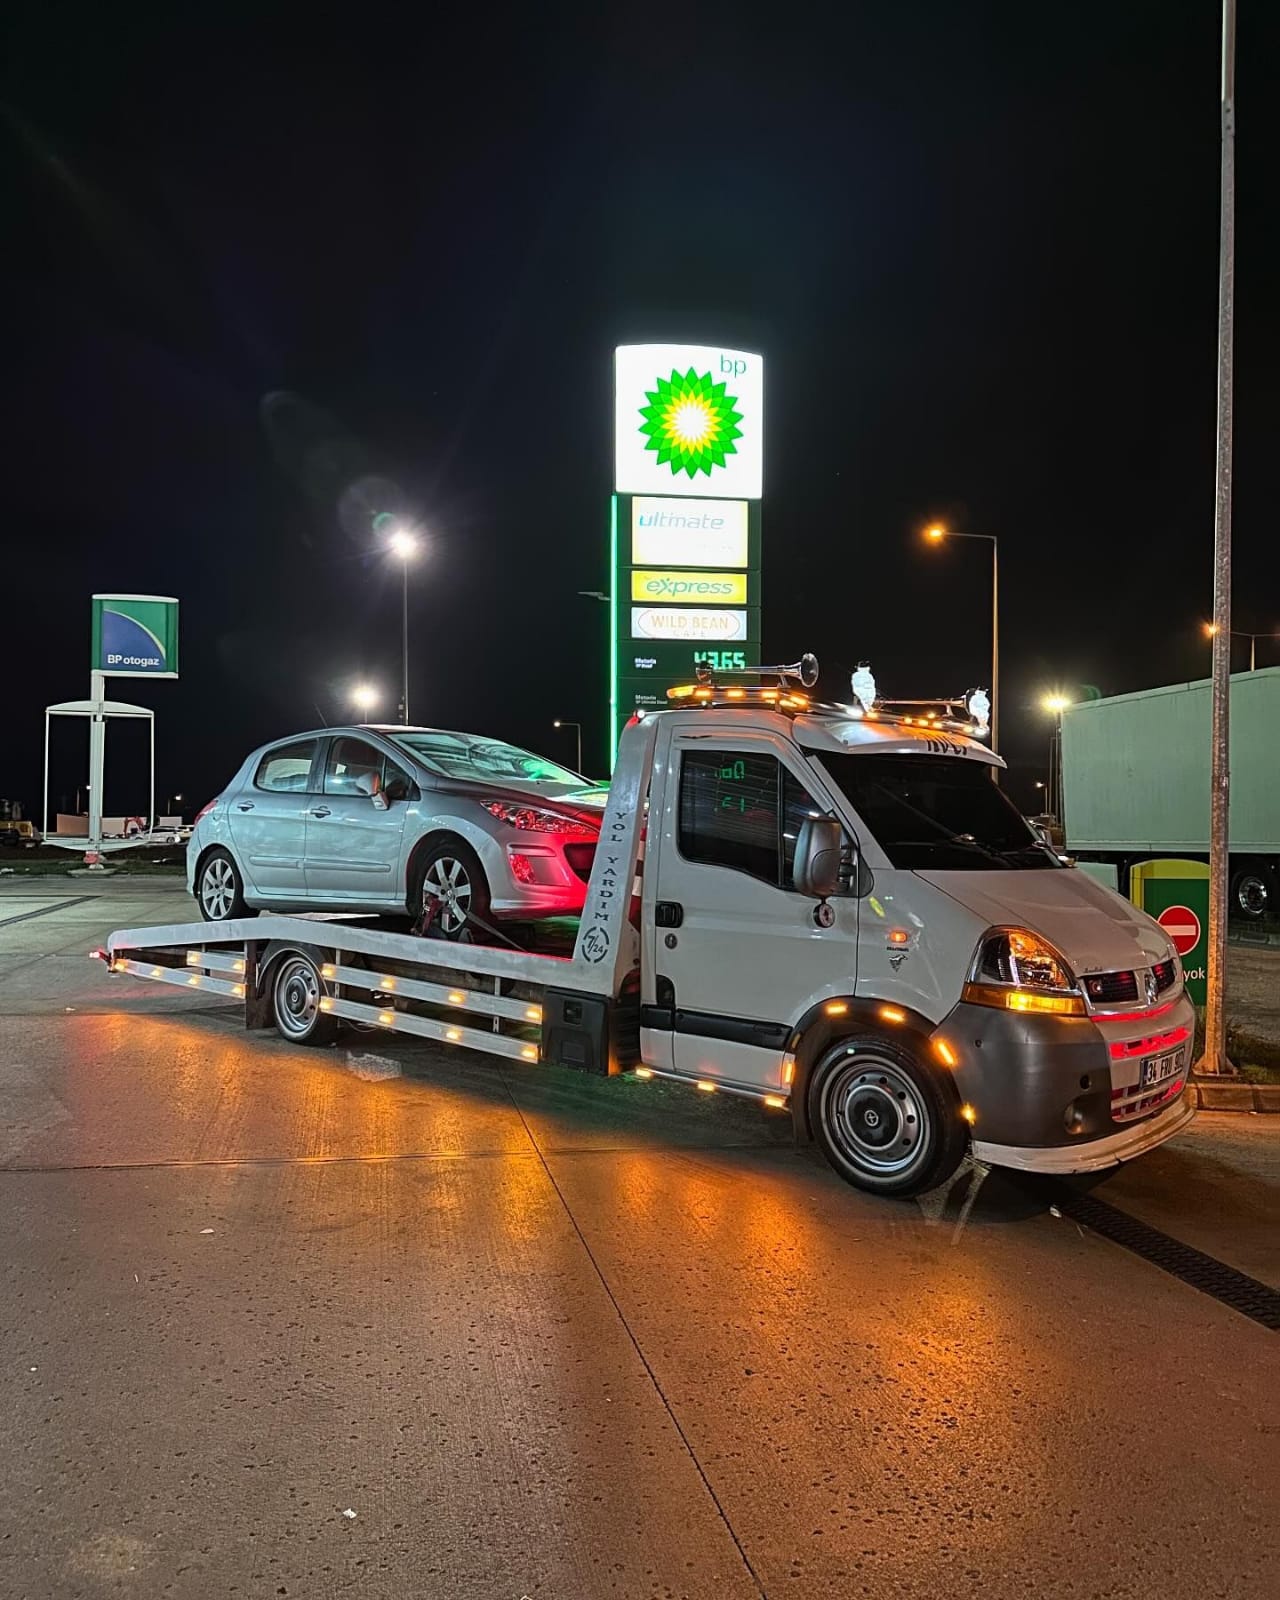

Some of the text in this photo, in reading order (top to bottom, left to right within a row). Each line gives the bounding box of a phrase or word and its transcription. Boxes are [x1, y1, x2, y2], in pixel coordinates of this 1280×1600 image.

[720, 354, 747, 378] bp
[639, 511, 725, 530] ultimate
[646, 577, 733, 597] express
[650, 615, 729, 630] WILD BEAN
[107, 654, 160, 667] BP otogaz
[594, 812, 628, 921] YOL YARDIM
[587, 935, 604, 954] 7/24
[1183, 967, 1206, 982] yok
